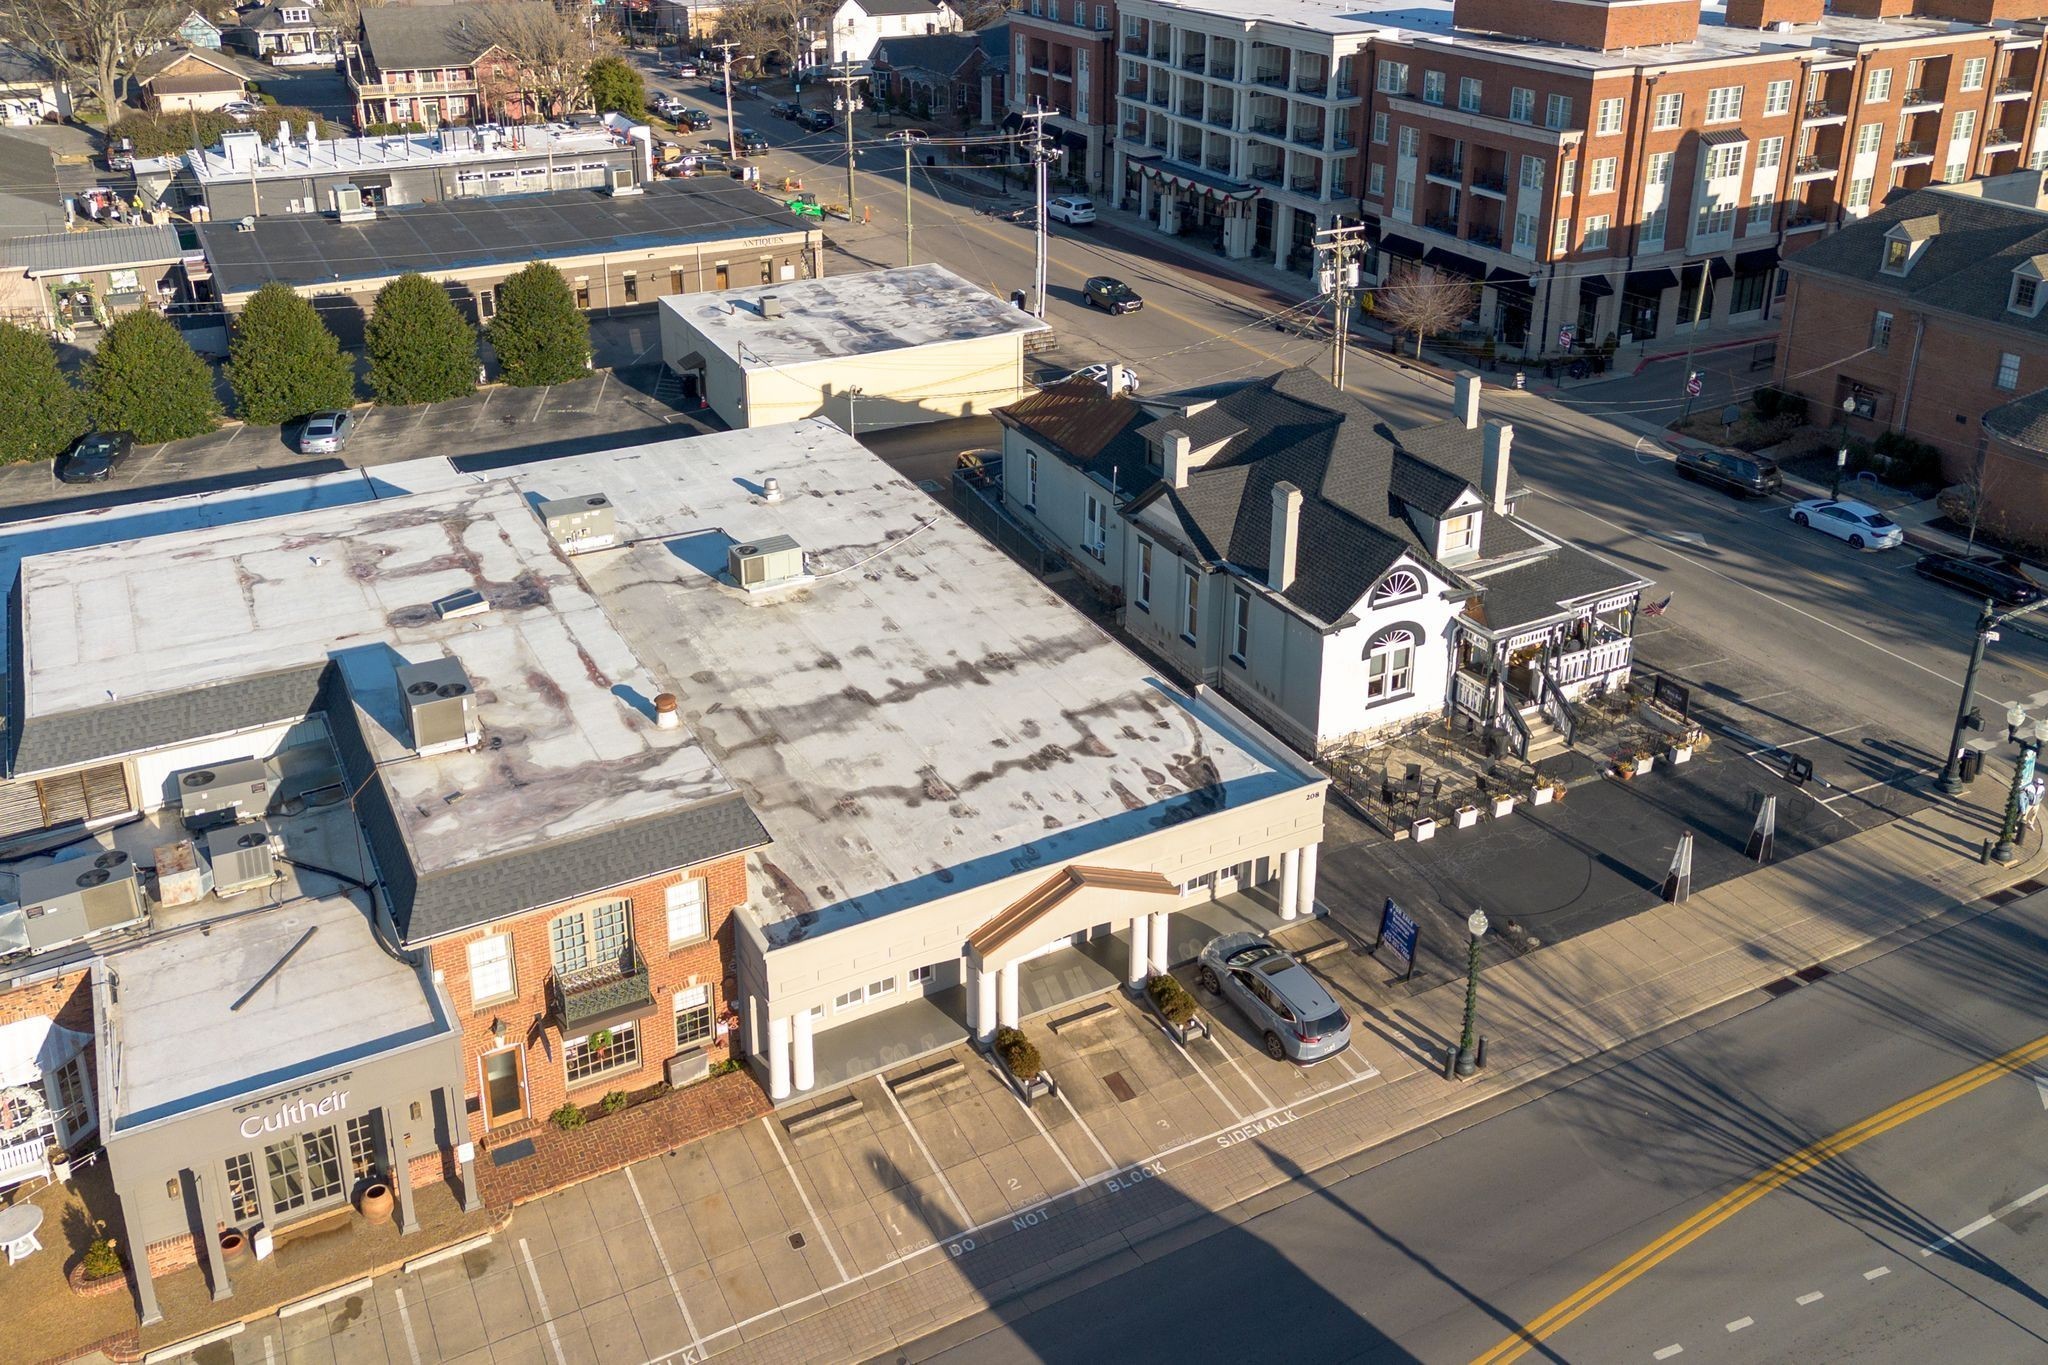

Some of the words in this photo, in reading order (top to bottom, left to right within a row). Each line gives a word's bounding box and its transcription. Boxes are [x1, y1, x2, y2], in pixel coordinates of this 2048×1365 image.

[742, 236, 784, 248] ANTIQUES
[1306, 792, 1320, 800] 208
[240, 1090, 350, 1138] Cultheir
[1156, 1119, 1170, 1130] 3
[948, 1238, 976, 1257] DO
[1011, 1208, 1050, 1232] NOT
[1105, 1161, 1167, 1193] BLOCK
[1216, 1110, 1300, 1148] SIDEWALK
[1007, 1178, 1022, 1191] 2
[891, 1223, 902, 1236] 1
[886, 1239, 930, 1261] RESERVED
